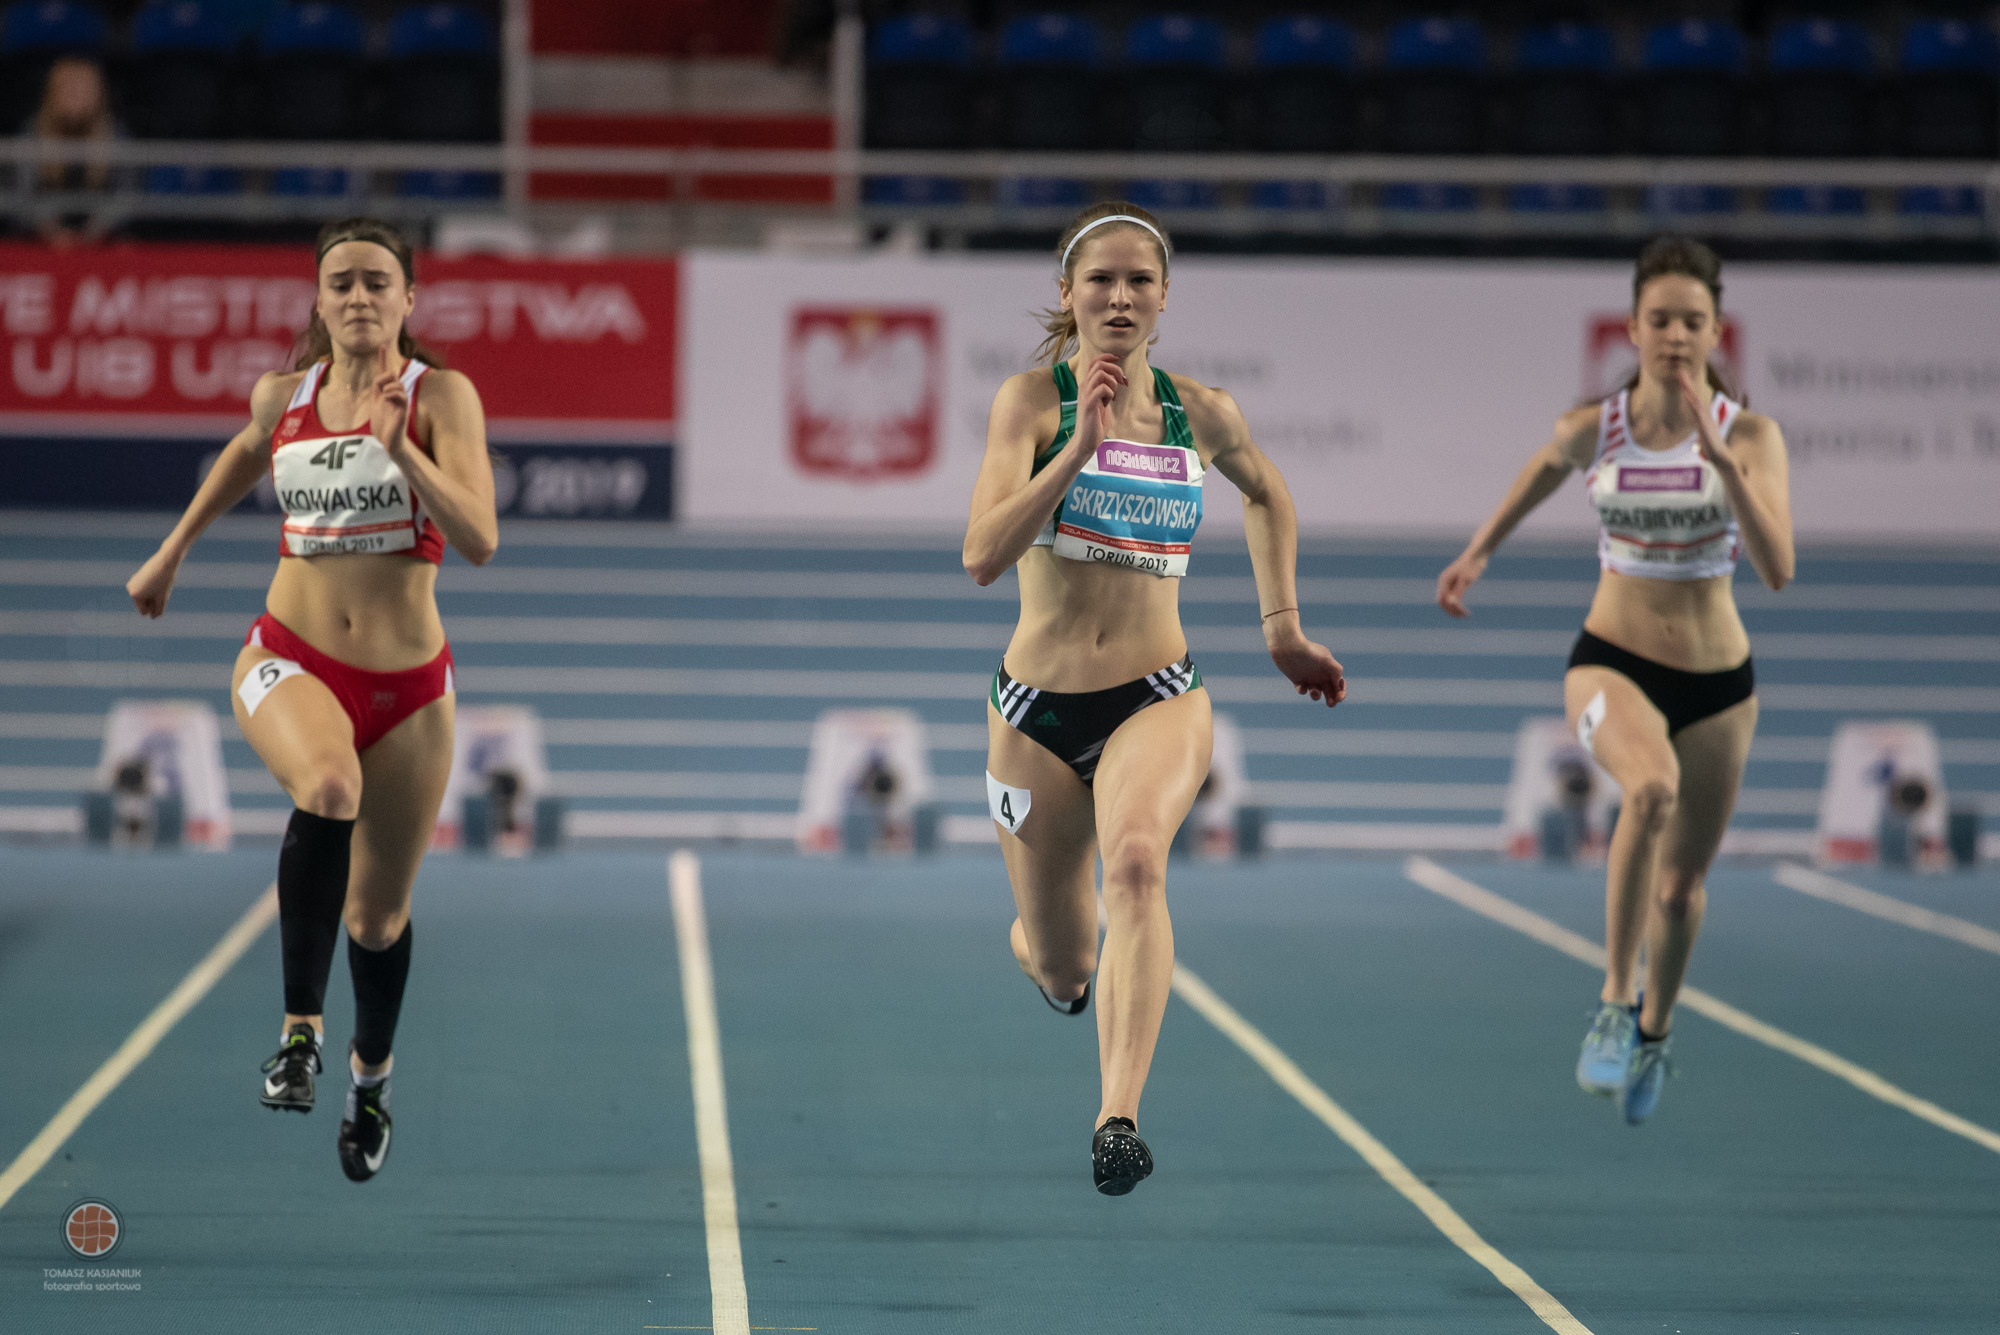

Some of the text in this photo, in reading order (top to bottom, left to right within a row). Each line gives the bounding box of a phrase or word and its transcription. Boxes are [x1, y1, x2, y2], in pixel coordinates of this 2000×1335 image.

[310, 438, 363, 470] 4F
[1105, 449, 1181, 474] noskiewicz
[281, 484, 403, 513] KOWALSKA
[1069, 485, 1197, 530] SKRZYSZOWSKA
[1085, 545, 1169, 572] TORUŃ 2019
[258, 662, 281, 689] 5
[1000, 790, 1016, 828] 4
